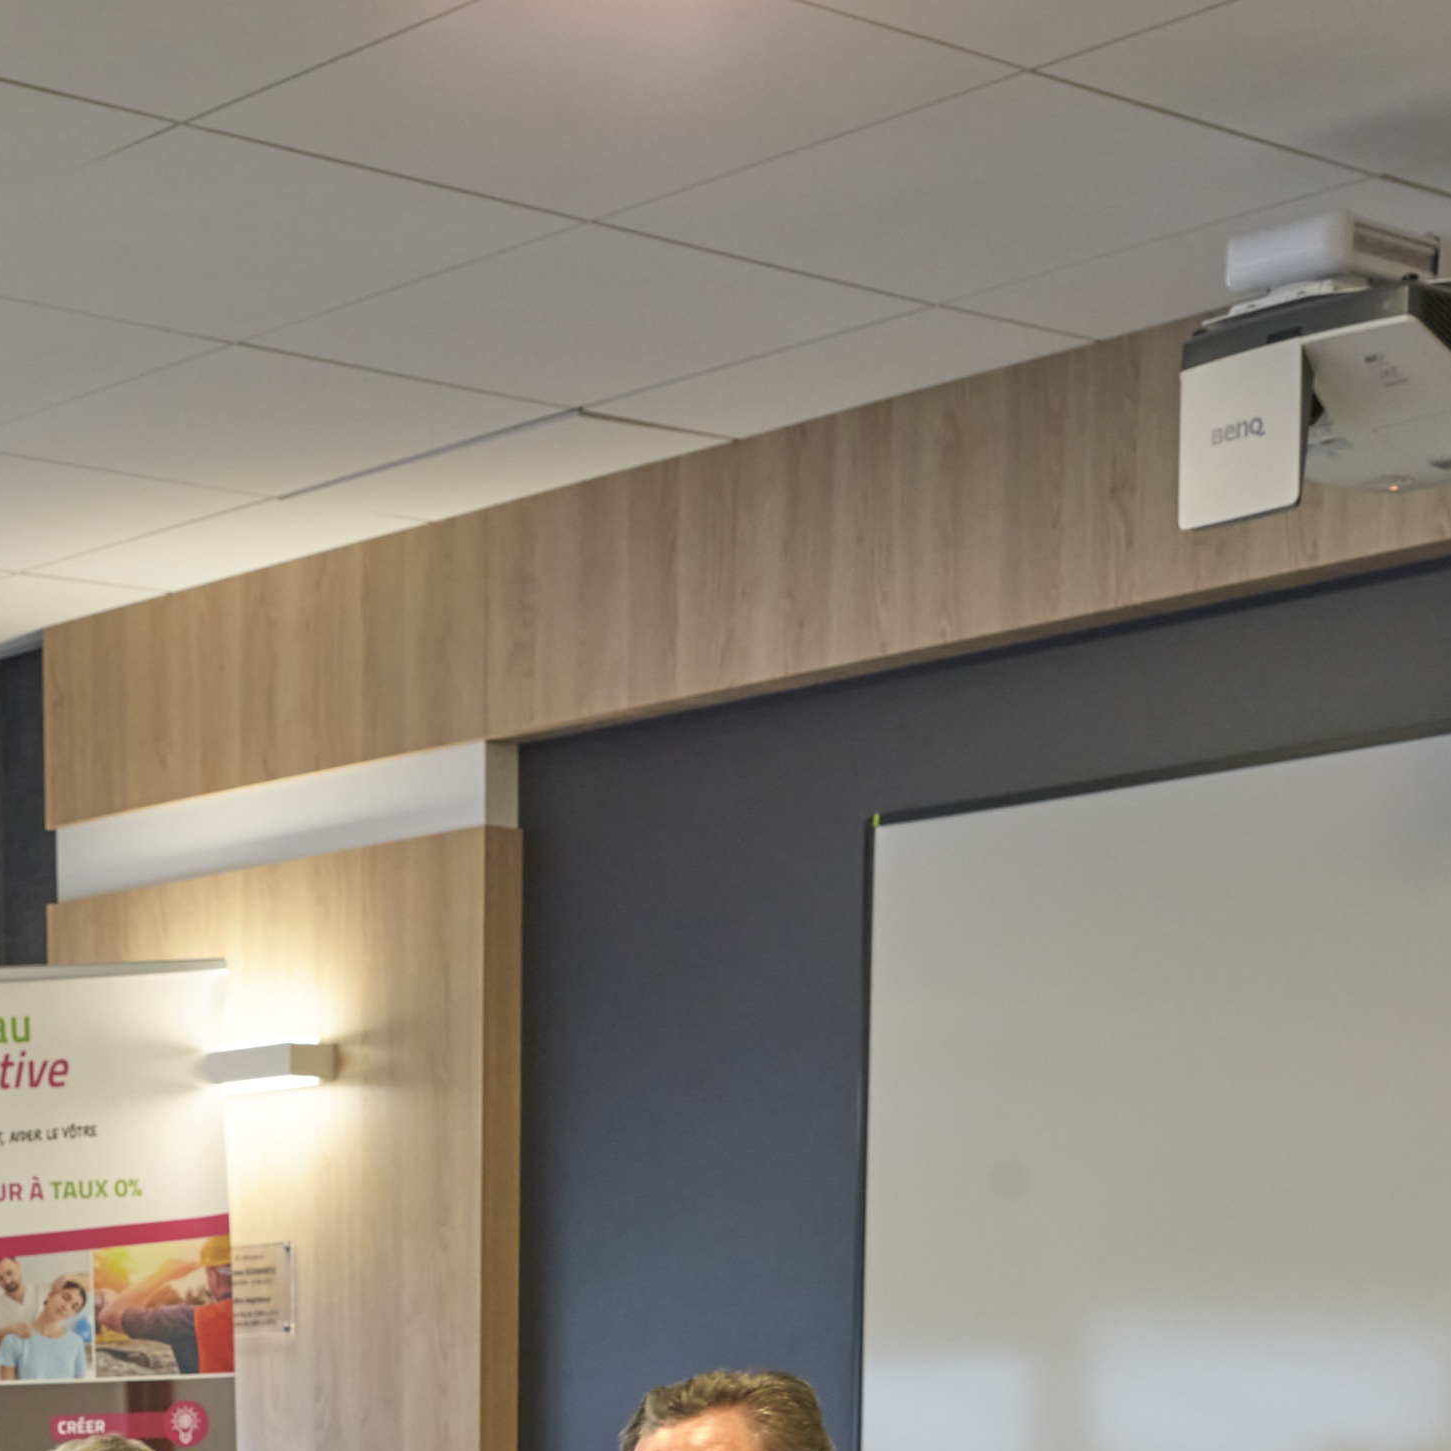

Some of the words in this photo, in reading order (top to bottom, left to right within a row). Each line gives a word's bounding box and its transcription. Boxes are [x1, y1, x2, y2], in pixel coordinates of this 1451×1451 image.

[1211, 417, 1266, 446] BenQ
[46, 1127, 58, 1140] LE
[29, 1176, 44, 1200] À
[51, 1178, 108, 1200] TAUX
[114, 1178, 143, 1197] 0%
[57, 1416, 106, 1435] CRÉER
